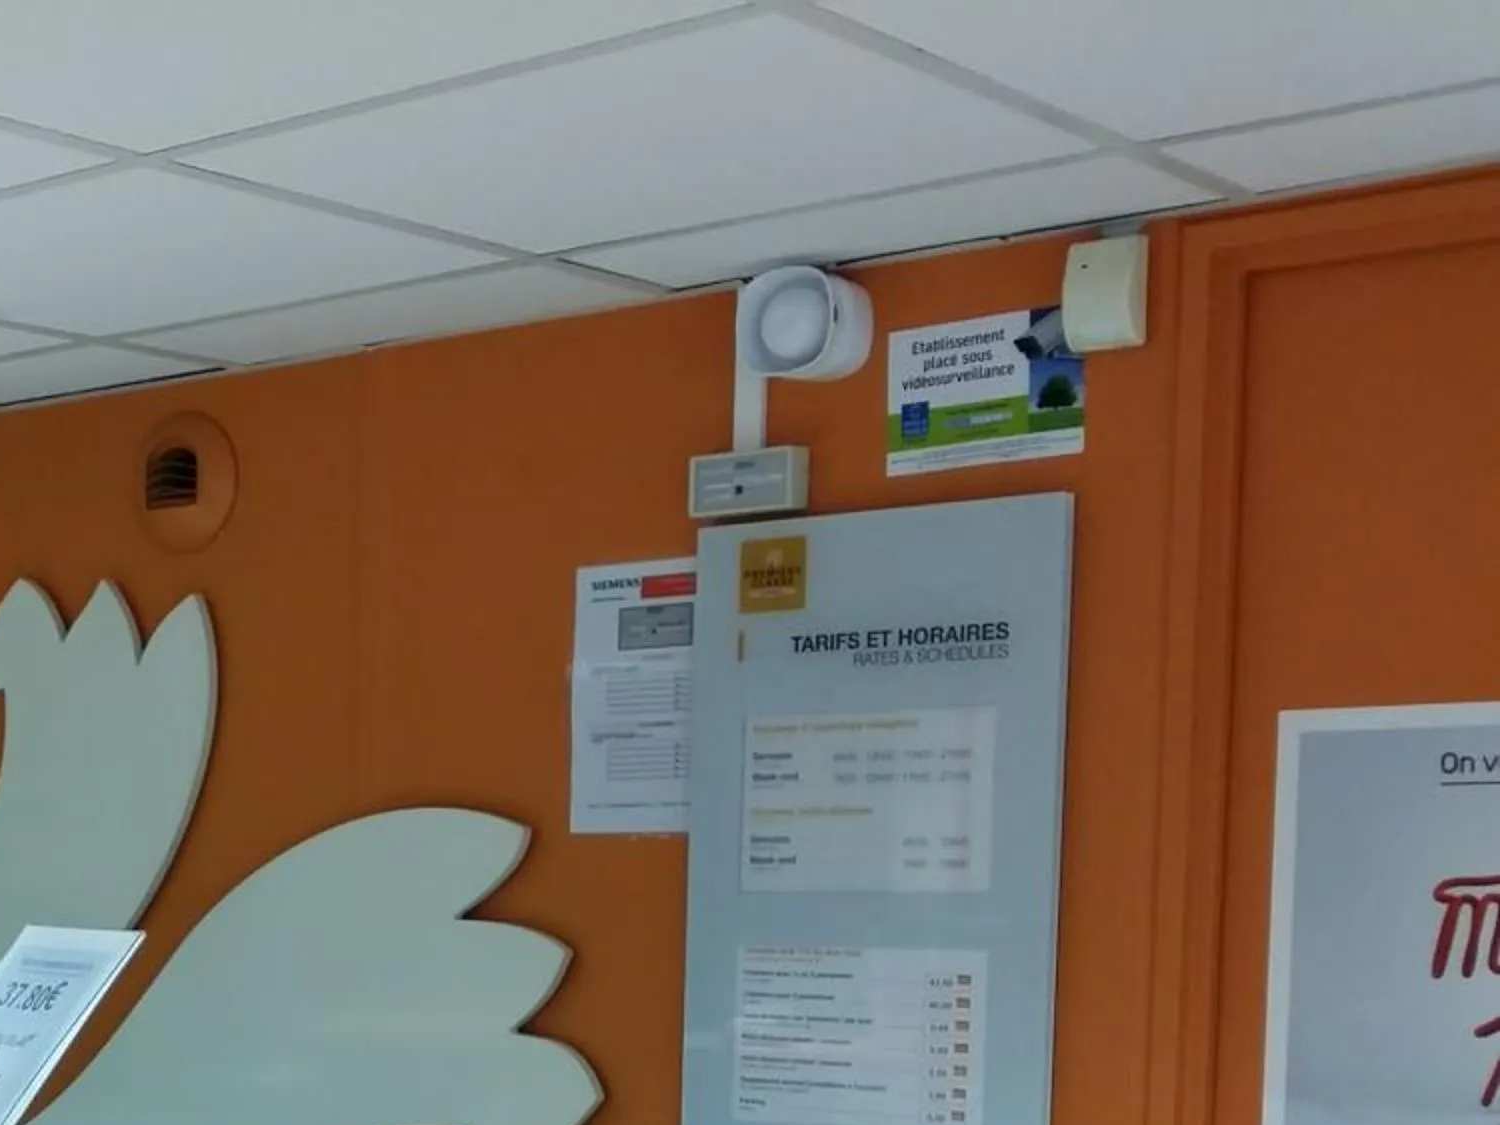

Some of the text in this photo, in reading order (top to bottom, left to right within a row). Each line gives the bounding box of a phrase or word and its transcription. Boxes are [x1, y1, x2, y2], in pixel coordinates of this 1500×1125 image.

[962, 349, 993, 366] sous
[791, 621, 1010, 653] TARIFS ET HORAIRES
[853, 650, 899, 667] RATES
[916, 643, 1010, 663] SCHEDULES
[1440, 751, 1475, 774] On
